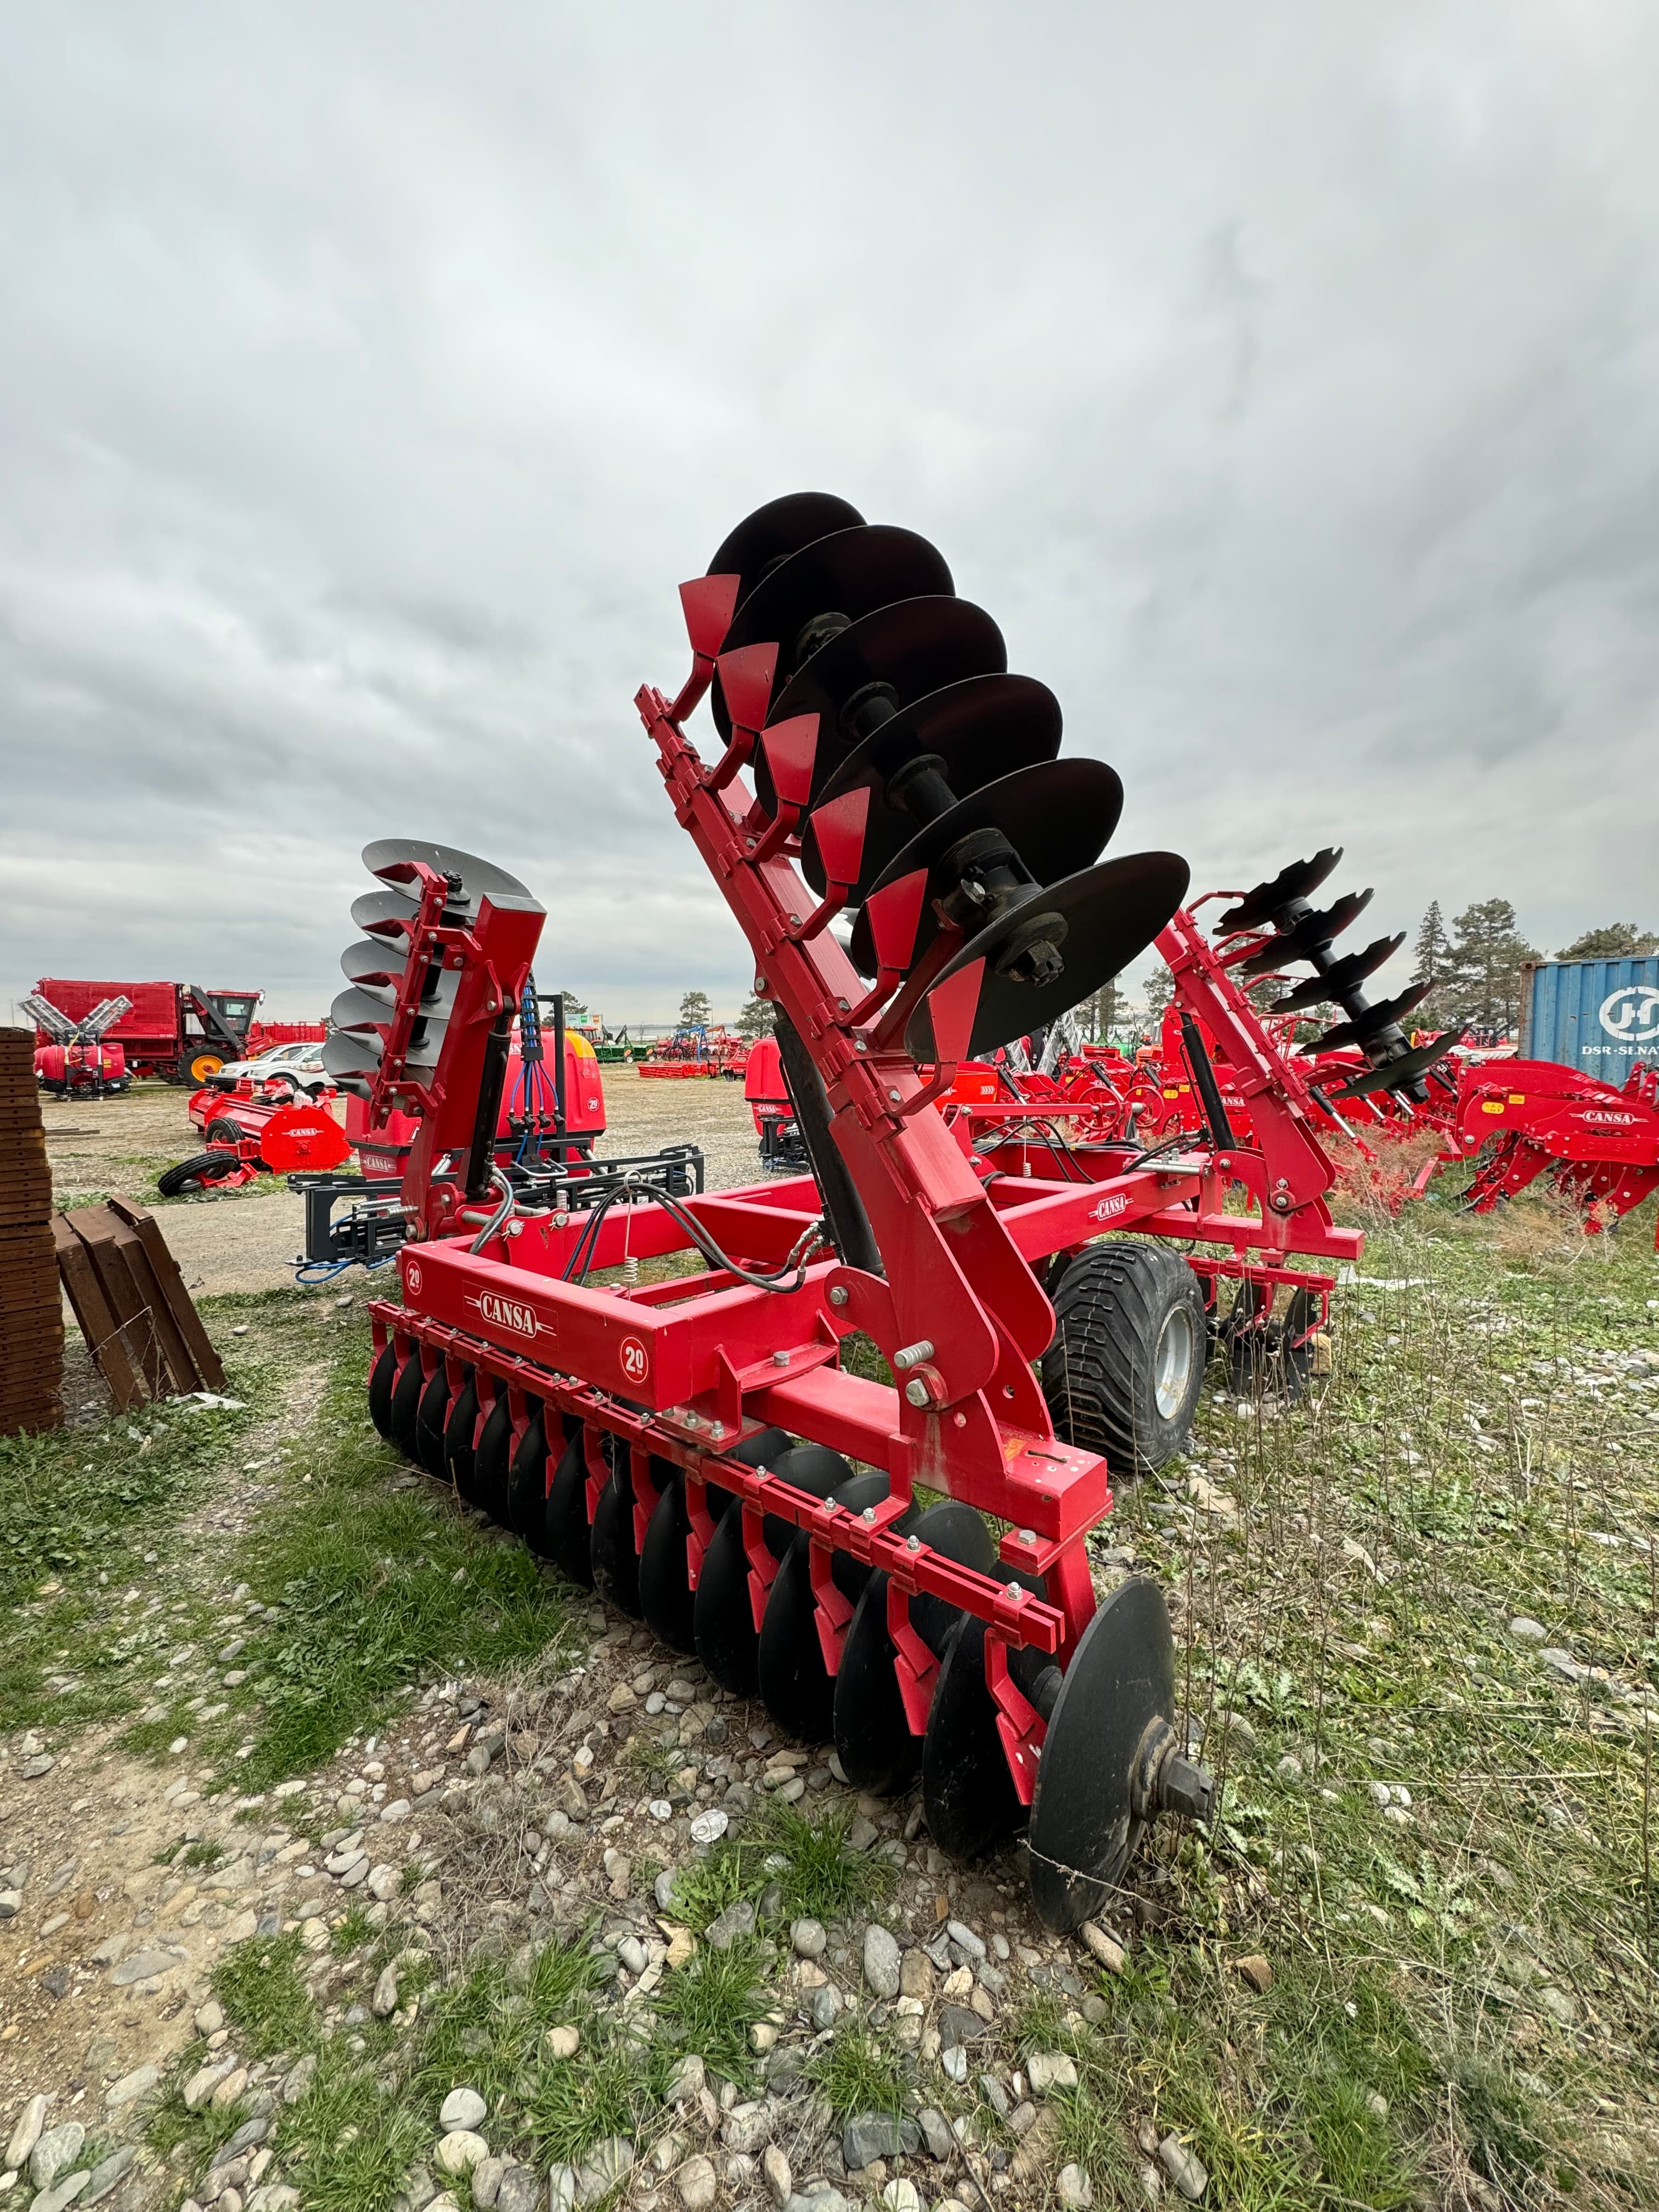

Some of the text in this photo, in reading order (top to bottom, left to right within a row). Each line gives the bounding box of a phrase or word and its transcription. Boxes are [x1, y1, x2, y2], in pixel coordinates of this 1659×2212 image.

[1582, 1046, 1659, 1055] DSR-SENA
[589, 1100, 598, 1109] 20
[1221, 1097, 1245, 1105] ANSA
[1585, 1112, 1630, 1124] CANSA
[367, 1156, 388, 1171] CANSA
[1099, 1196, 1124, 1218] CANSA
[409, 1268, 420, 1287] 20
[483, 1295, 534, 1335] CANSA
[625, 1346, 644, 1373] 20
